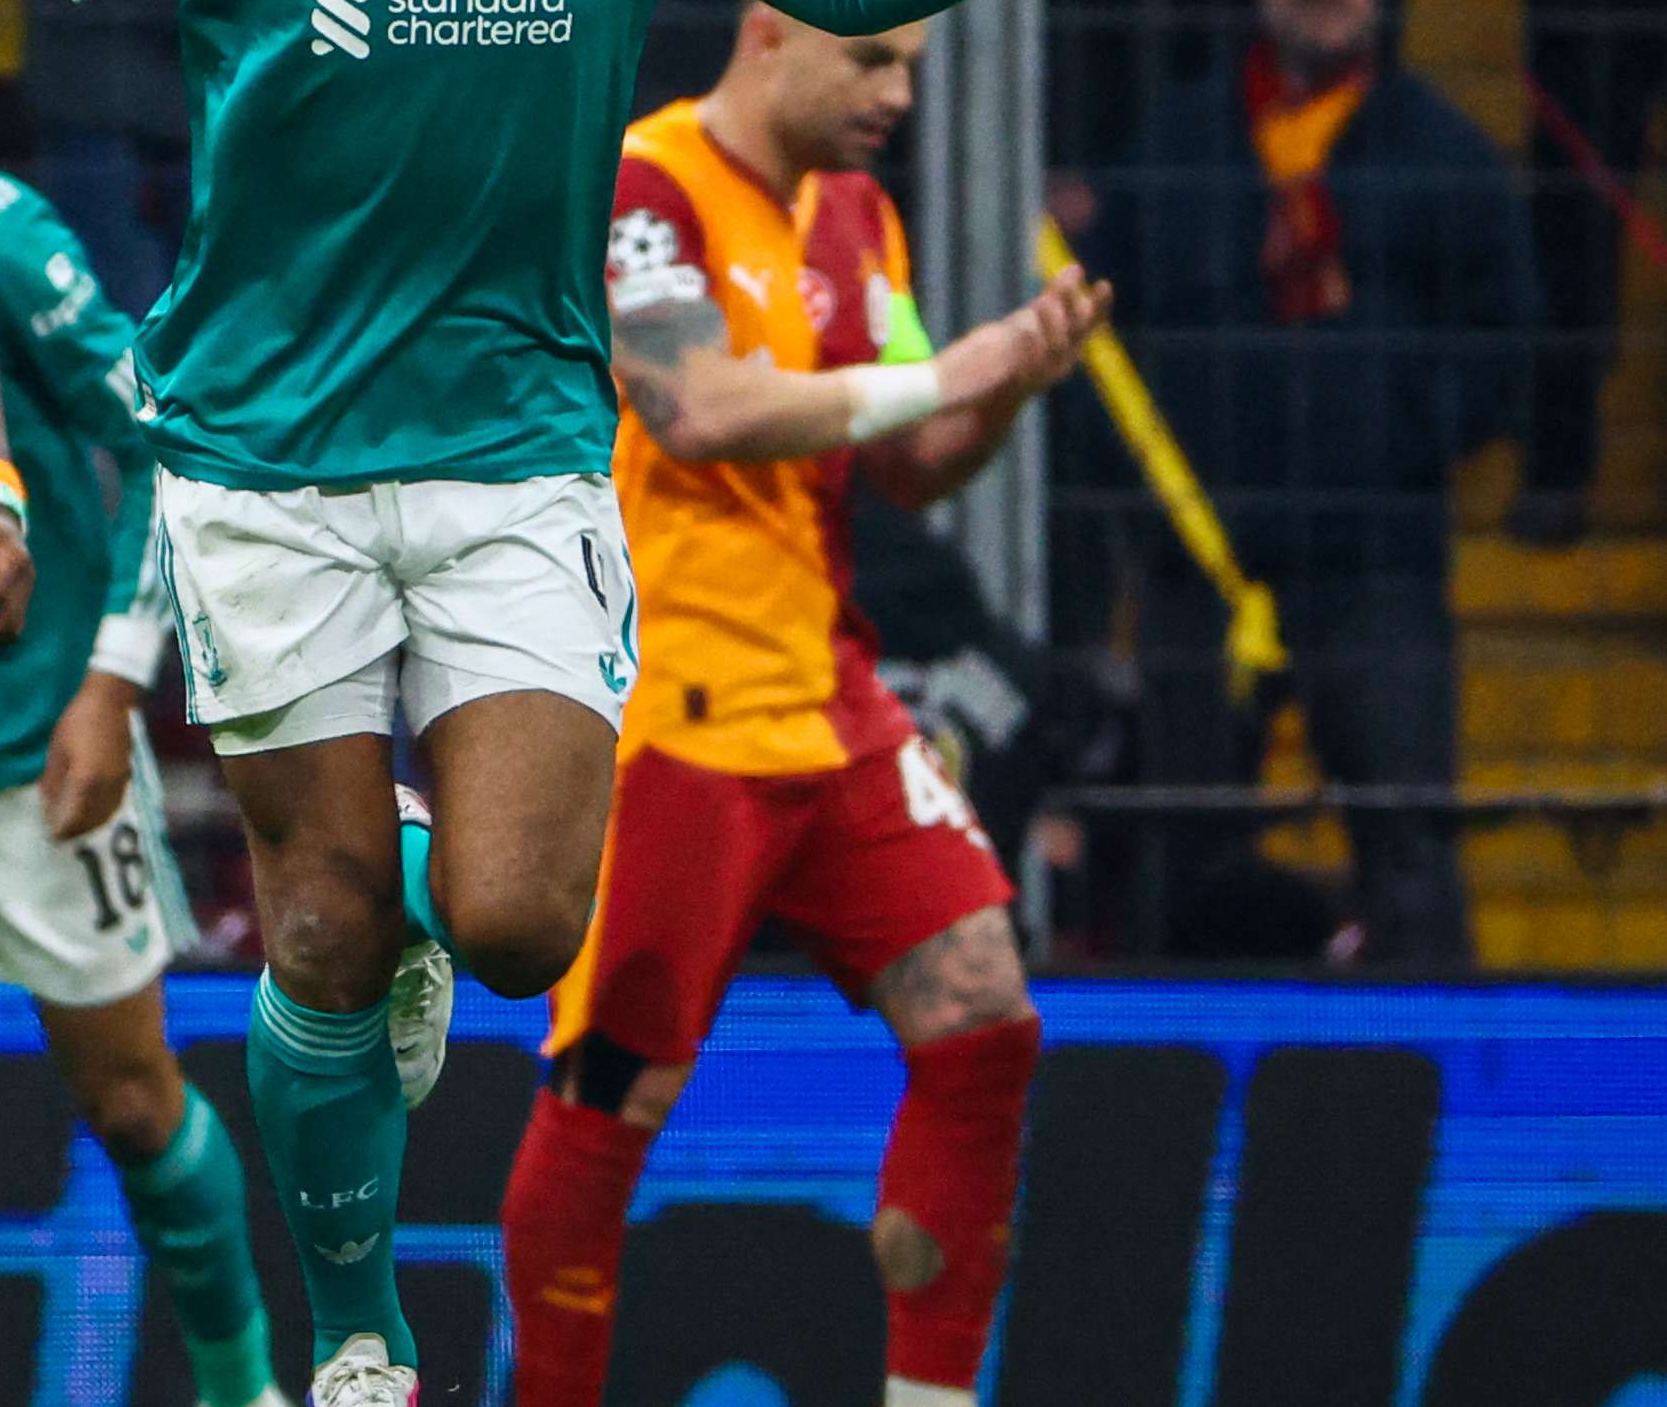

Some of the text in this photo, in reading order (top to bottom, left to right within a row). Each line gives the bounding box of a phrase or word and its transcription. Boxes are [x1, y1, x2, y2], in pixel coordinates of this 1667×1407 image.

[387, 12, 573, 46] chartered
[74, 821, 154, 932] 18
[299, 1176, 379, 1210] LFC
